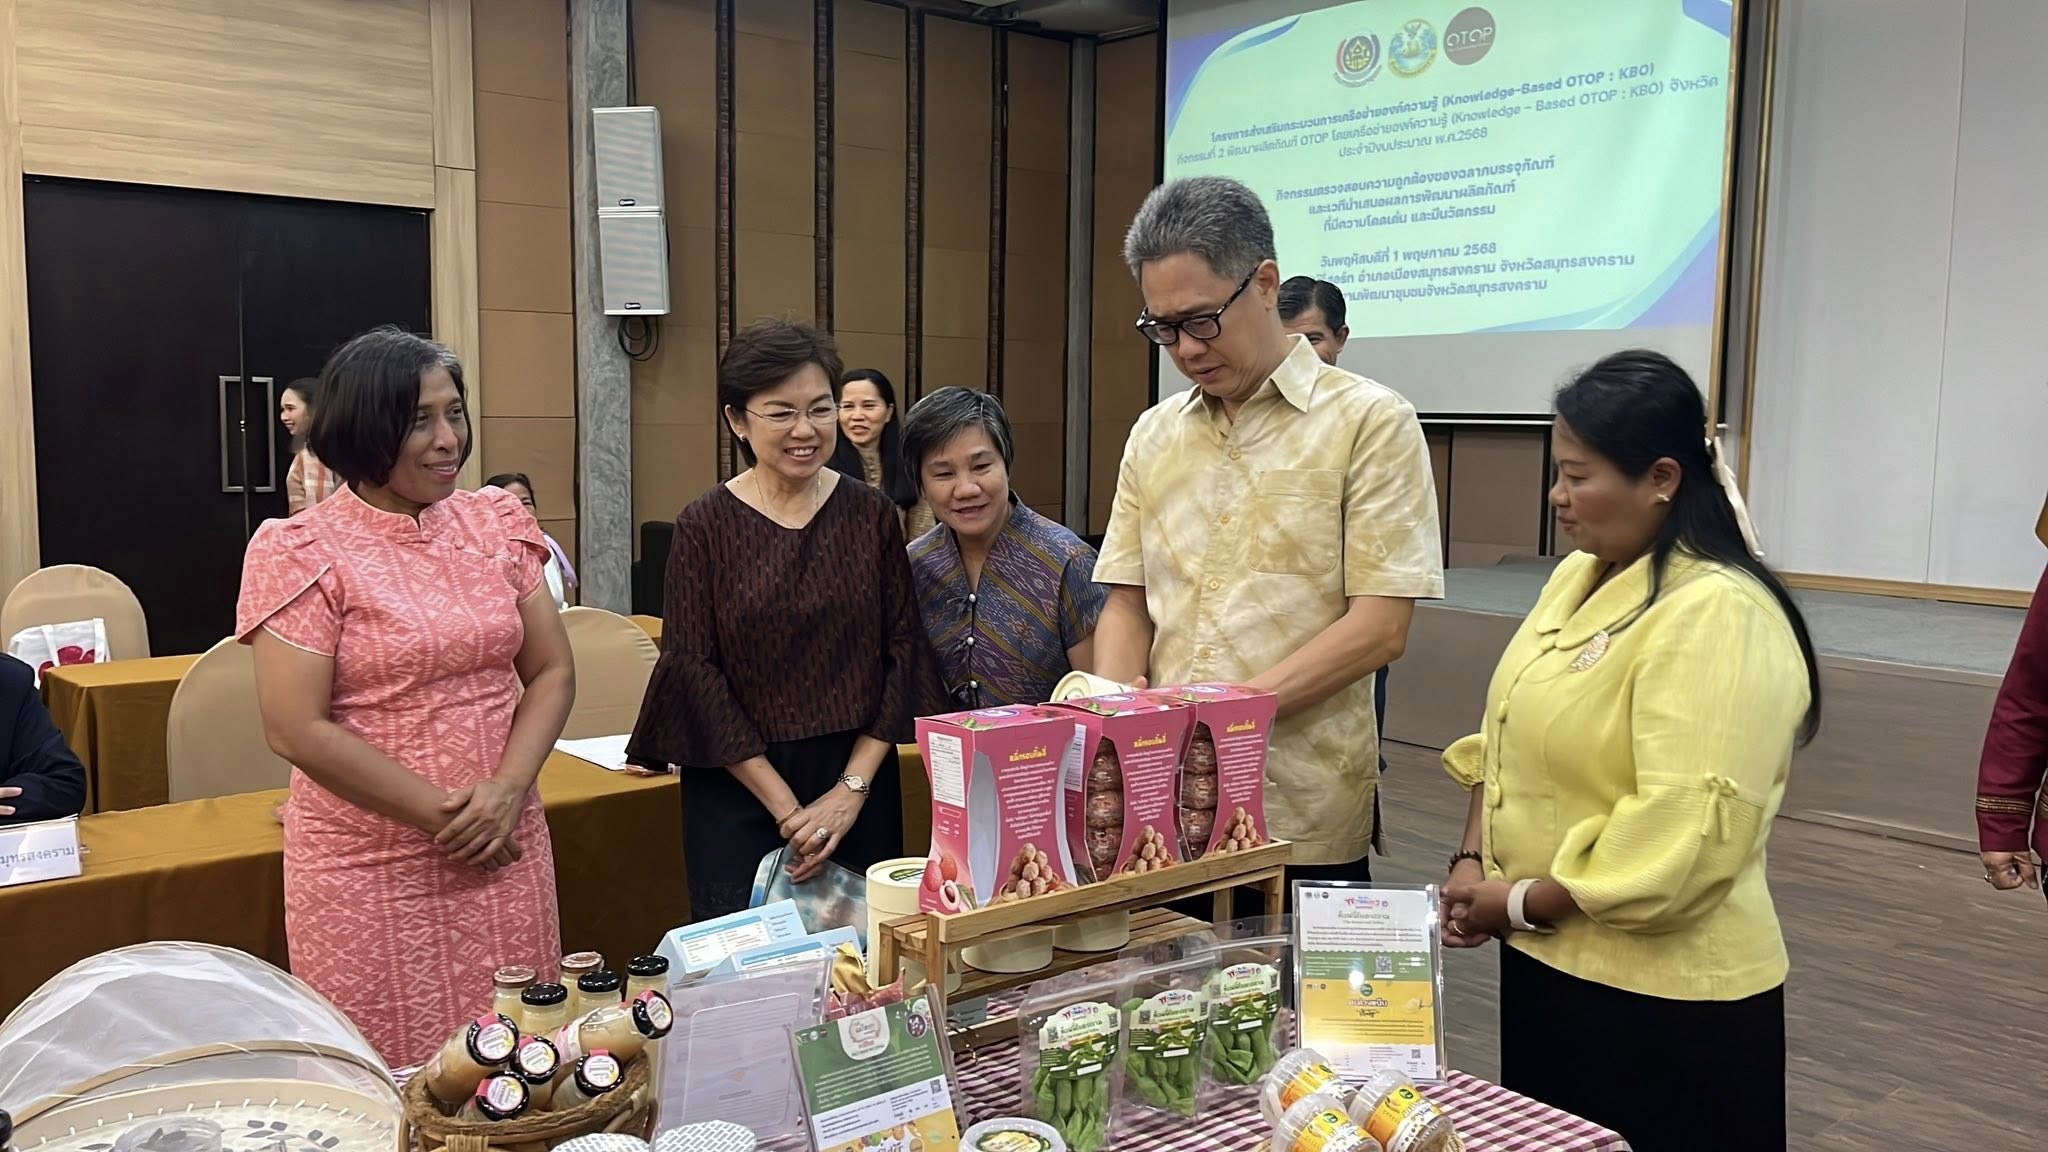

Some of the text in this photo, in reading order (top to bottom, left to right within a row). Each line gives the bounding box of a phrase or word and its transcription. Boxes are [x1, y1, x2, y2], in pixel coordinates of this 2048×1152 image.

[1447, 26, 1493, 47] OTOP
[1442, 77, 1562, 108] (Knowledge-Based
[1566, 71, 1605, 88] OTOP
[1619, 62, 1655, 80] KBO)
[1218, 147, 1225, 159] 2
[1300, 132, 1329, 147] OTOP
[1451, 102, 1521, 125] (Knowledge
[1536, 95, 1576, 112] Based
[1579, 89, 1617, 106] OTOP
[1630, 80, 1664, 98] KBO)
[1669, 75, 1719, 93] จังหวัด
[1402, 247, 1460, 262] พฤษภาคม
[1463, 242, 1497, 257] 2568
[1500, 254, 1635, 275] จังหวัดสมุทรสงคราม
[1344, 278, 1548, 302] านพัฒนาชุมชนจังหวัดสมุทรสงคราม
